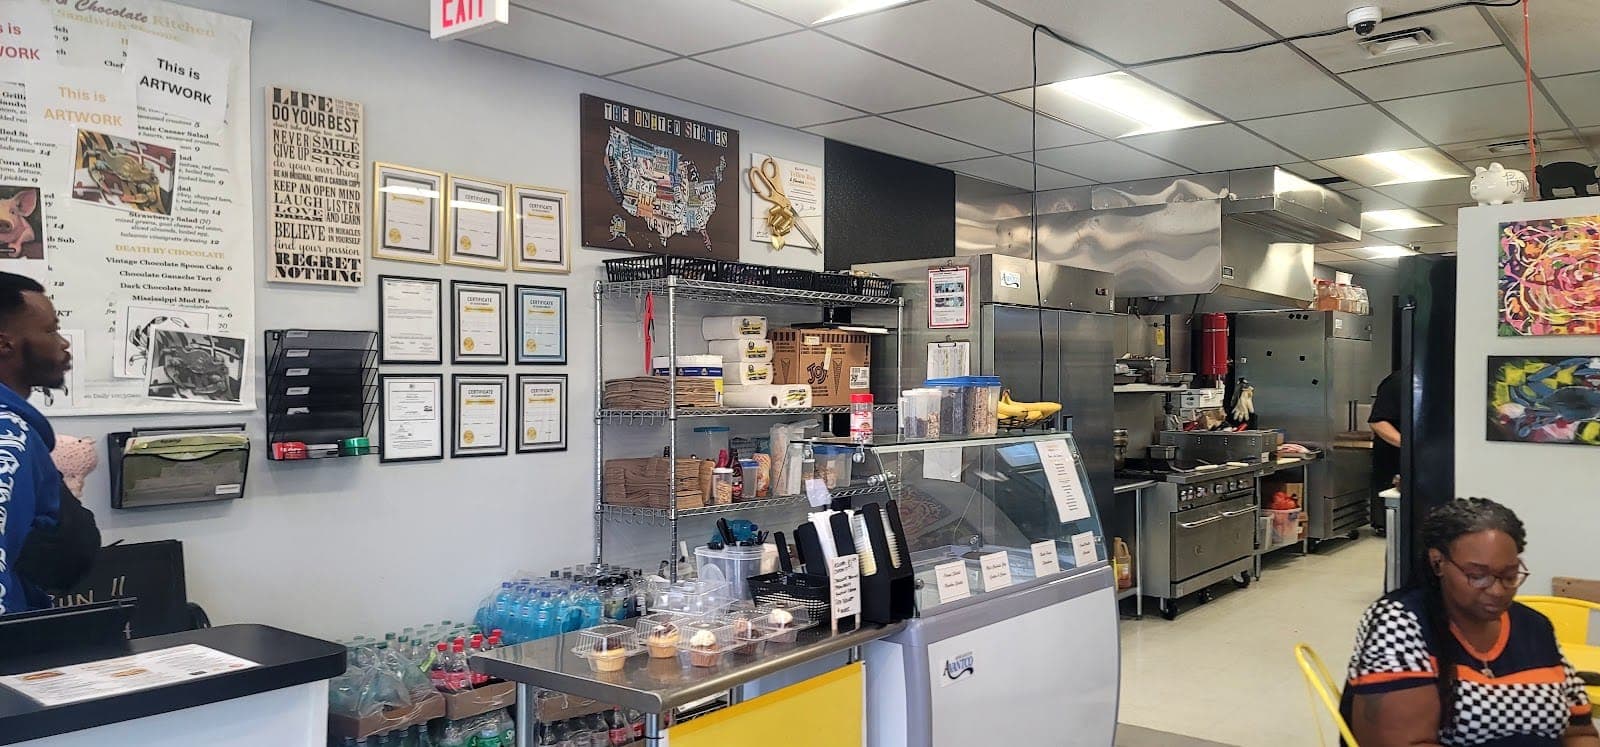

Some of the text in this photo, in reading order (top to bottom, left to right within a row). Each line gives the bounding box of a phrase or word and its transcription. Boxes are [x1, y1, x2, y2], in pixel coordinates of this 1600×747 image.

[152, 16, 216, 37] Kitchen
[0, 46, 40, 60] ORK
[157, 58, 200, 80] This is
[58, 86, 107, 103] This is
[139, 75, 212, 105] ARTWORK
[273, 87, 334, 113] LIFE
[43, 108, 122, 127] ARTWORK
[272, 104, 289, 122] DO
[292, 107, 326, 128] YOUR
[327, 113, 359, 135] BEST
[604, 103, 728, 148] THE UNITED STATES
[187, 131, 209, 139] Salad
[273, 129, 310, 148] NEVER
[273, 144, 310, 161] GIVE UP
[312, 136, 360, 155] SMILE
[312, 155, 360, 169] SING
[274, 180, 360, 200] KEEP AN OPEN MIND
[275, 193, 322, 208] LAUGH
[326, 199, 360, 214] LISTEN
[465, 194, 491, 203] CERTIFICATE
[528, 202, 553, 210] CERTIFICATE
[275, 205, 323, 217] LOVE
[326, 212, 360, 225] AND LEARN
[176, 216, 198, 224] Salad
[275, 221, 326, 241] BELIEVE
[115, 244, 148, 255] DEATH
[168, 249, 225, 260] CHOCOLATE
[326, 247, 359, 256] passion
[105, 257, 138, 266] Vintage
[139, 259, 179, 268] Chocolate
[180, 263, 205, 271] Spoon
[275, 252, 361, 270] REGRET
[119, 271, 160, 279] Chocolate
[161, 273, 195, 281] Ganache
[275, 266, 361, 282] NOTHING
[142, 284, 182, 292] Chocolate
[132, 295, 177, 304] Mississippi
